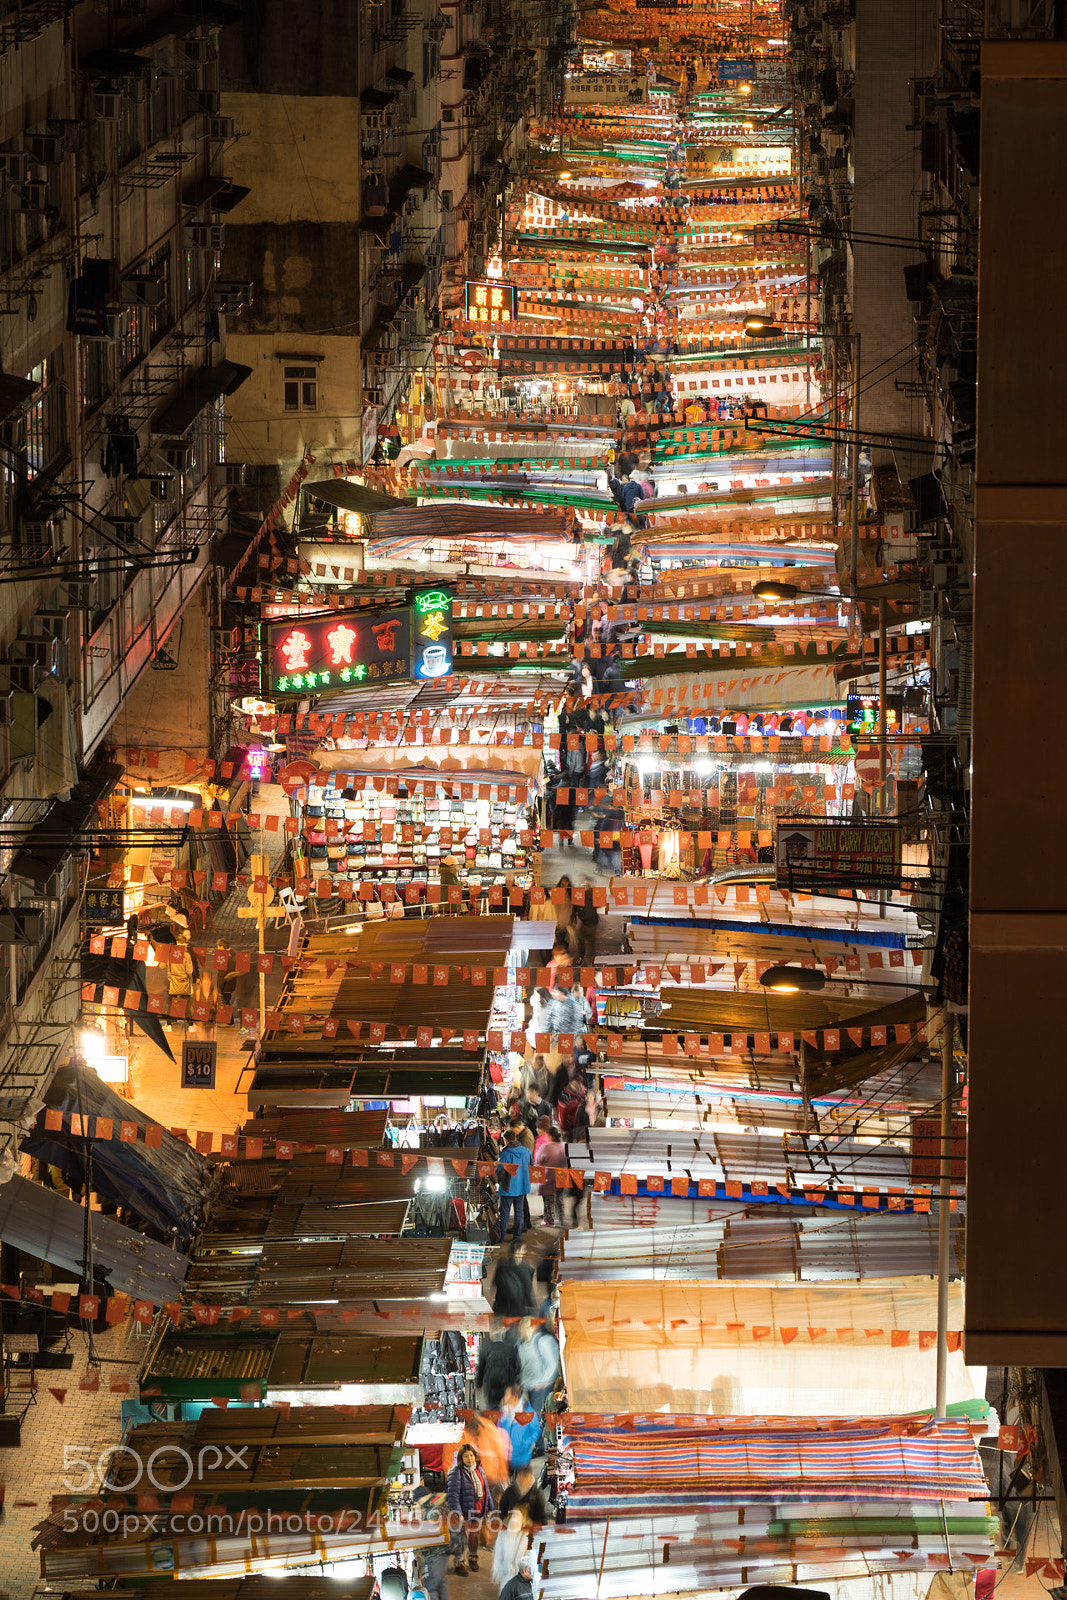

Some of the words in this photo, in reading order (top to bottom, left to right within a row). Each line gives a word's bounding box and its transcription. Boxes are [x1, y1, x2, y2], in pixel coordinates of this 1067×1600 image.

[817, 830, 837, 852] ASIAN
[839, 830, 862, 852] CURRY
[864, 831, 893, 853] KITCHEN
[188, 1048, 211, 1063] DVD
[187, 1064, 210, 1076] $10
